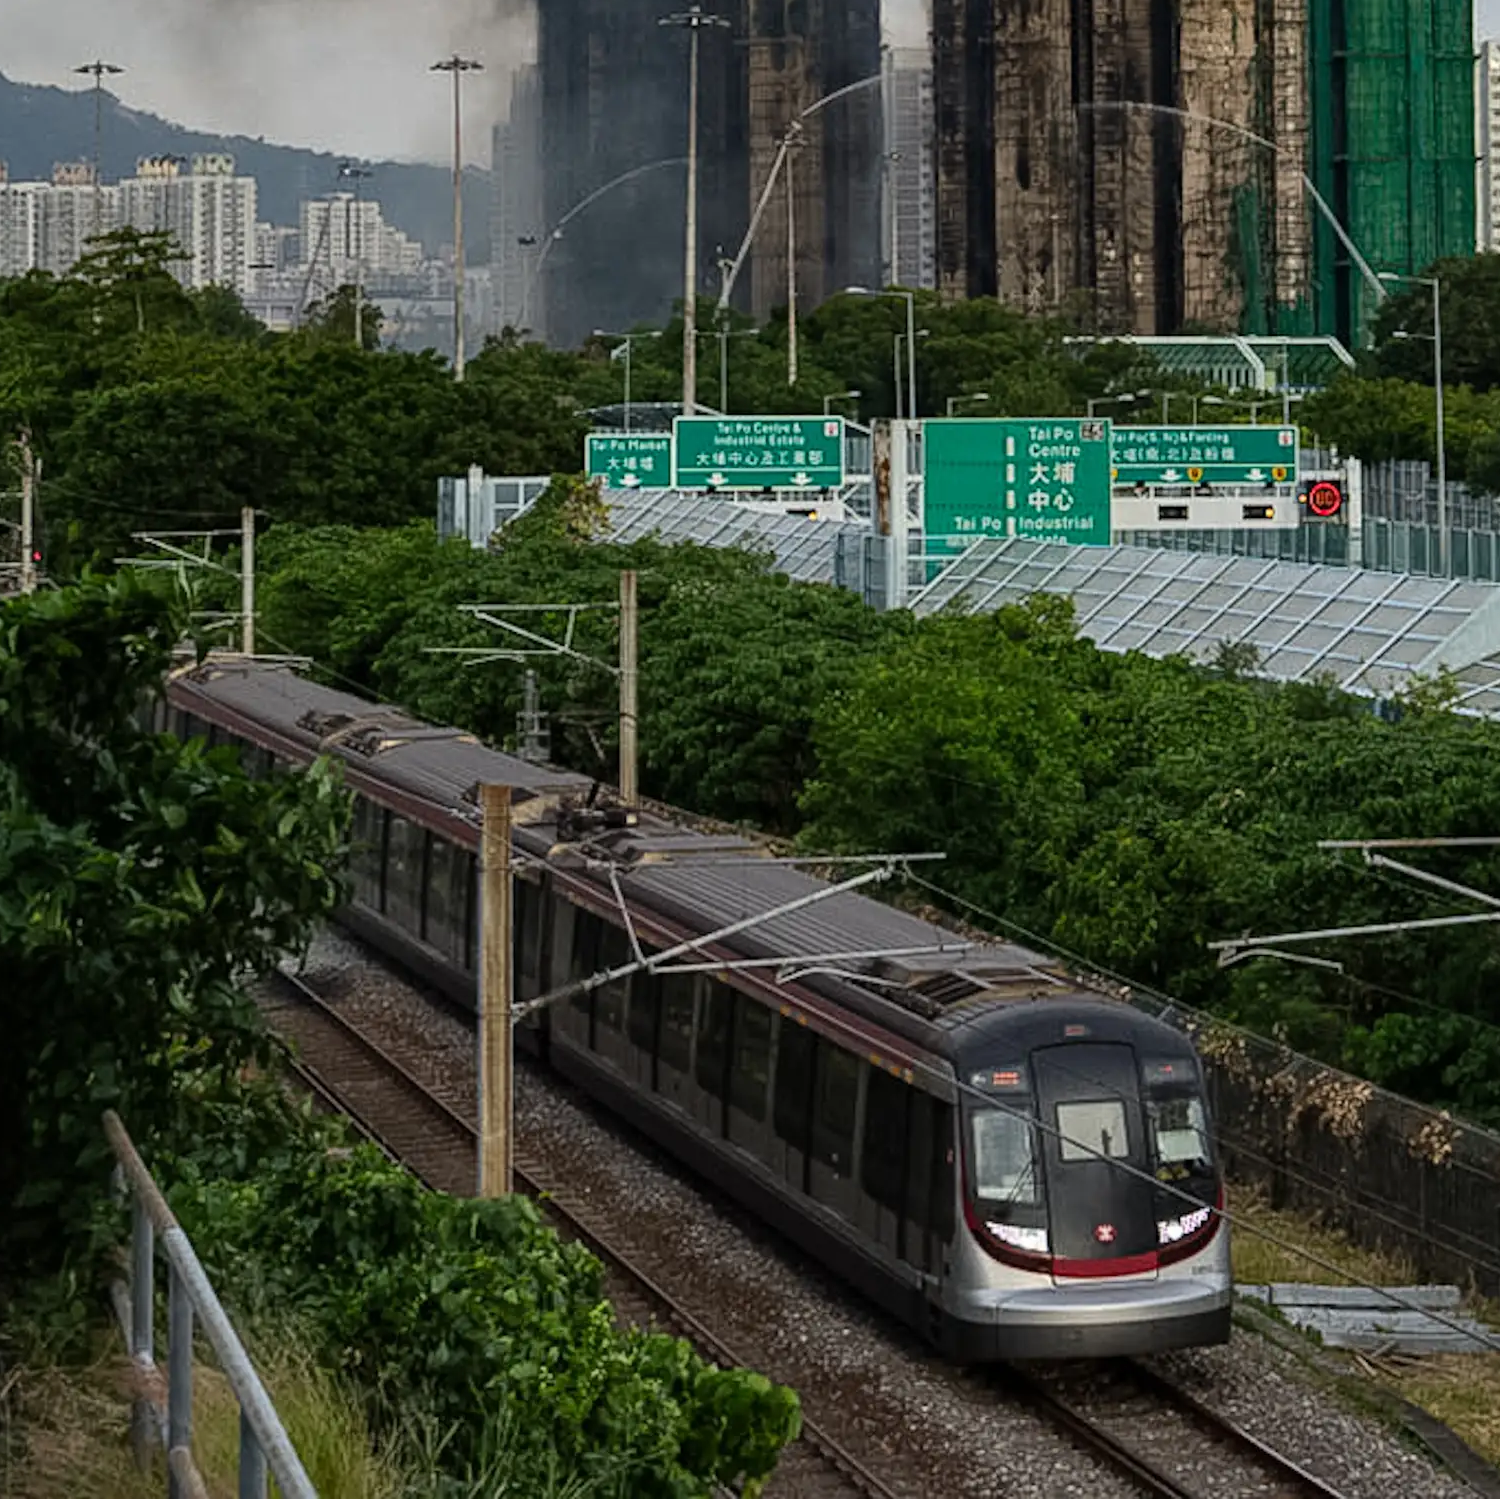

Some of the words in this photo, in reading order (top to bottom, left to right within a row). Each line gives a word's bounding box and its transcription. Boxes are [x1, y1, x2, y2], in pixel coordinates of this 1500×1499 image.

[1028, 426, 1050, 441] Tai
[1053, 426, 1074, 441] Po
[1028, 443, 1081, 458] Centre
[1029, 462, 1076, 485] 大埔
[1028, 488, 1074, 512] 中心
[954, 516, 976, 530] Tai
[982, 516, 1002, 530] Po
[1019, 515, 1094, 530] Industrial
